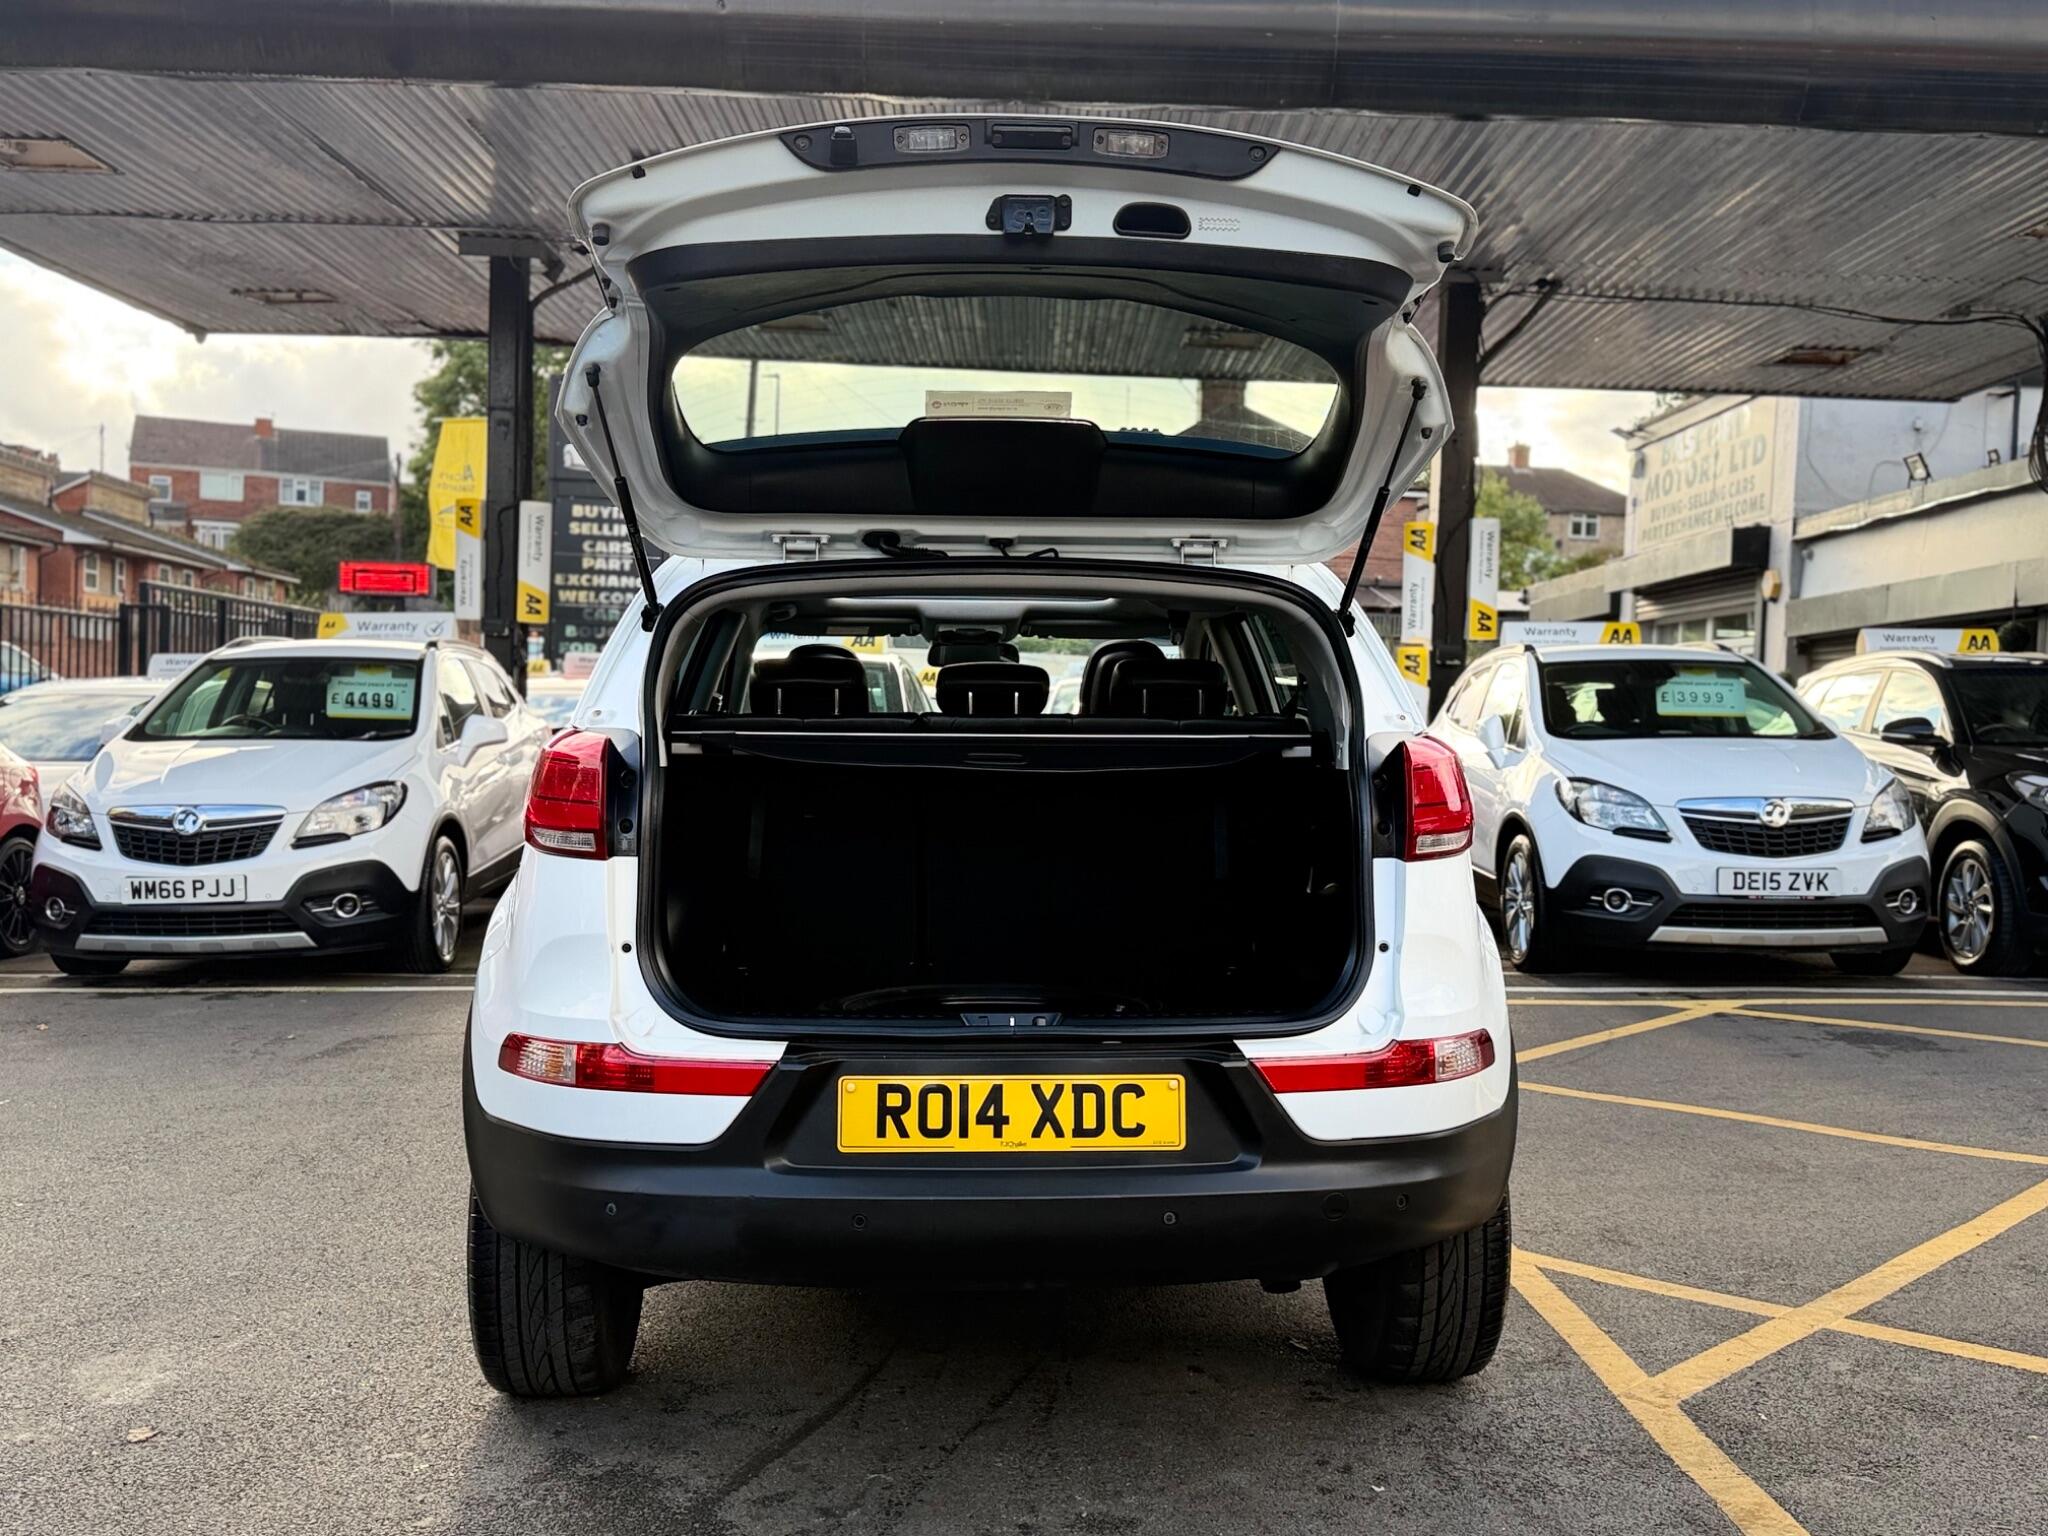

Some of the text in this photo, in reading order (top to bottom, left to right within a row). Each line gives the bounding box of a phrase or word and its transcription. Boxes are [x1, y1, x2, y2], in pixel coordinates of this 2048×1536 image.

[1728, 433, 1767, 474] LTD
[460, 505, 473, 528] AA
[571, 504, 625, 519] BUYI
[533, 515, 545, 563] Warranty
[568, 521, 629, 537] SELLIN
[1410, 528, 1427, 551] AA
[582, 540, 634, 554] CARS
[1484, 530, 1495, 578] Warranty
[581, 557, 633, 571] PART
[460, 559, 468, 606] Warranty
[554, 573, 642, 588] EXCHAN
[525, 592, 542, 617] AA
[558, 589, 635, 605] WELCO
[1408, 582, 1420, 629] Warranty
[356, 620, 418, 633] Warranty
[1477, 609, 1492, 632] AA
[851, 635, 876, 647] AA
[1523, 626, 1633, 644] Warranty AA
[1882, 633, 1991, 650] Warranty AA
[1404, 654, 1420, 676] AA
[922, 672, 936, 682] AA
[130, 878, 236, 900] WM66 PJJ
[1733, 871, 1829, 892] DE15 ZVK
[876, 1083, 1146, 1139] RO14 XDC
